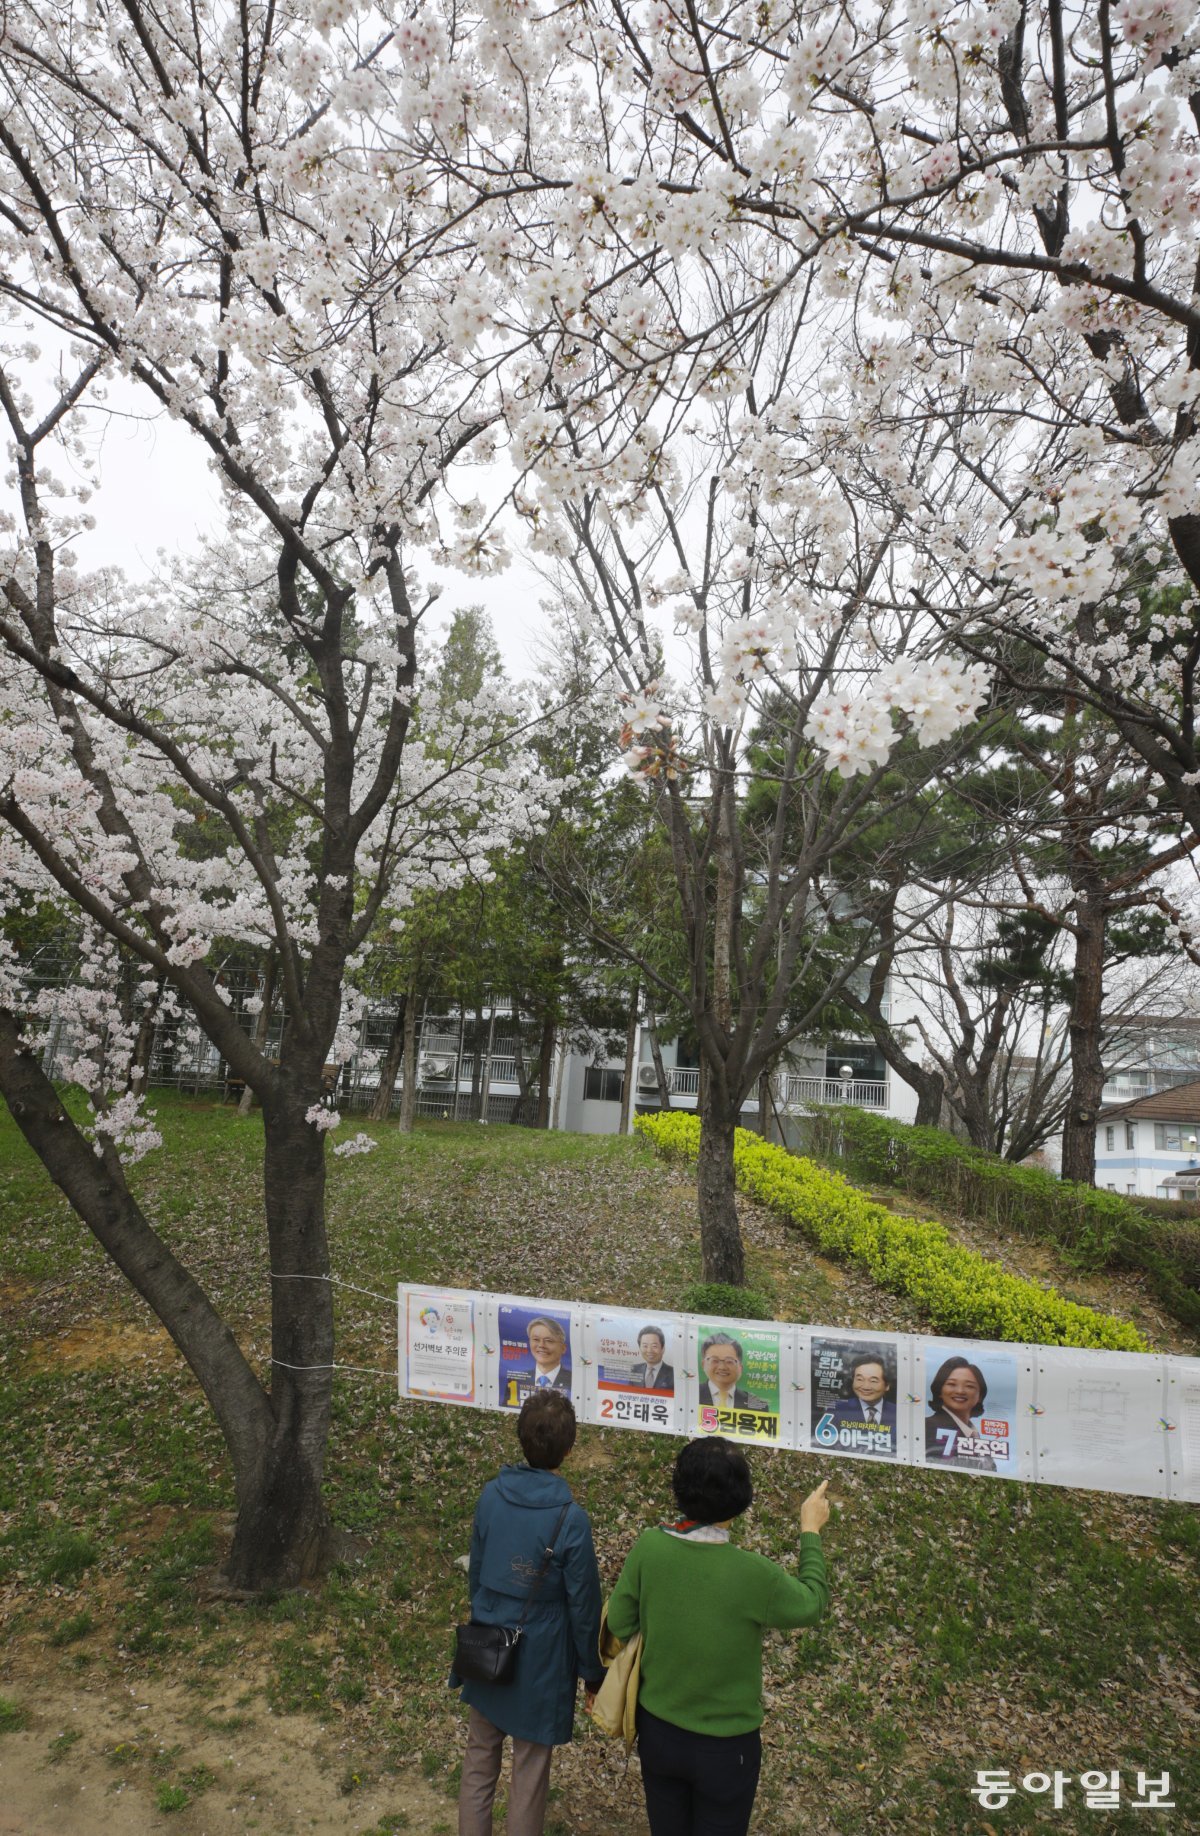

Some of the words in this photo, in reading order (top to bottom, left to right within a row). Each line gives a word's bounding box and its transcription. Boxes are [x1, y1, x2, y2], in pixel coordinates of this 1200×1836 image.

[413, 1342, 442, 1353] 선거벽보
[445, 1345, 468, 1357] 주의문
[814, 1369, 837, 1378] 광산이
[818, 1356, 843, 1371] 온다
[507, 1380, 519, 1407] 1
[601, 1398, 613, 1418] 2
[616, 1401, 668, 1425] 안태욱
[719, 1411, 777, 1439] 김용재
[815, 1412, 839, 1447] 6
[840, 1428, 892, 1453] 이낙연
[935, 1428, 958, 1457] 7
[957, 1436, 1009, 1460] 전주연
